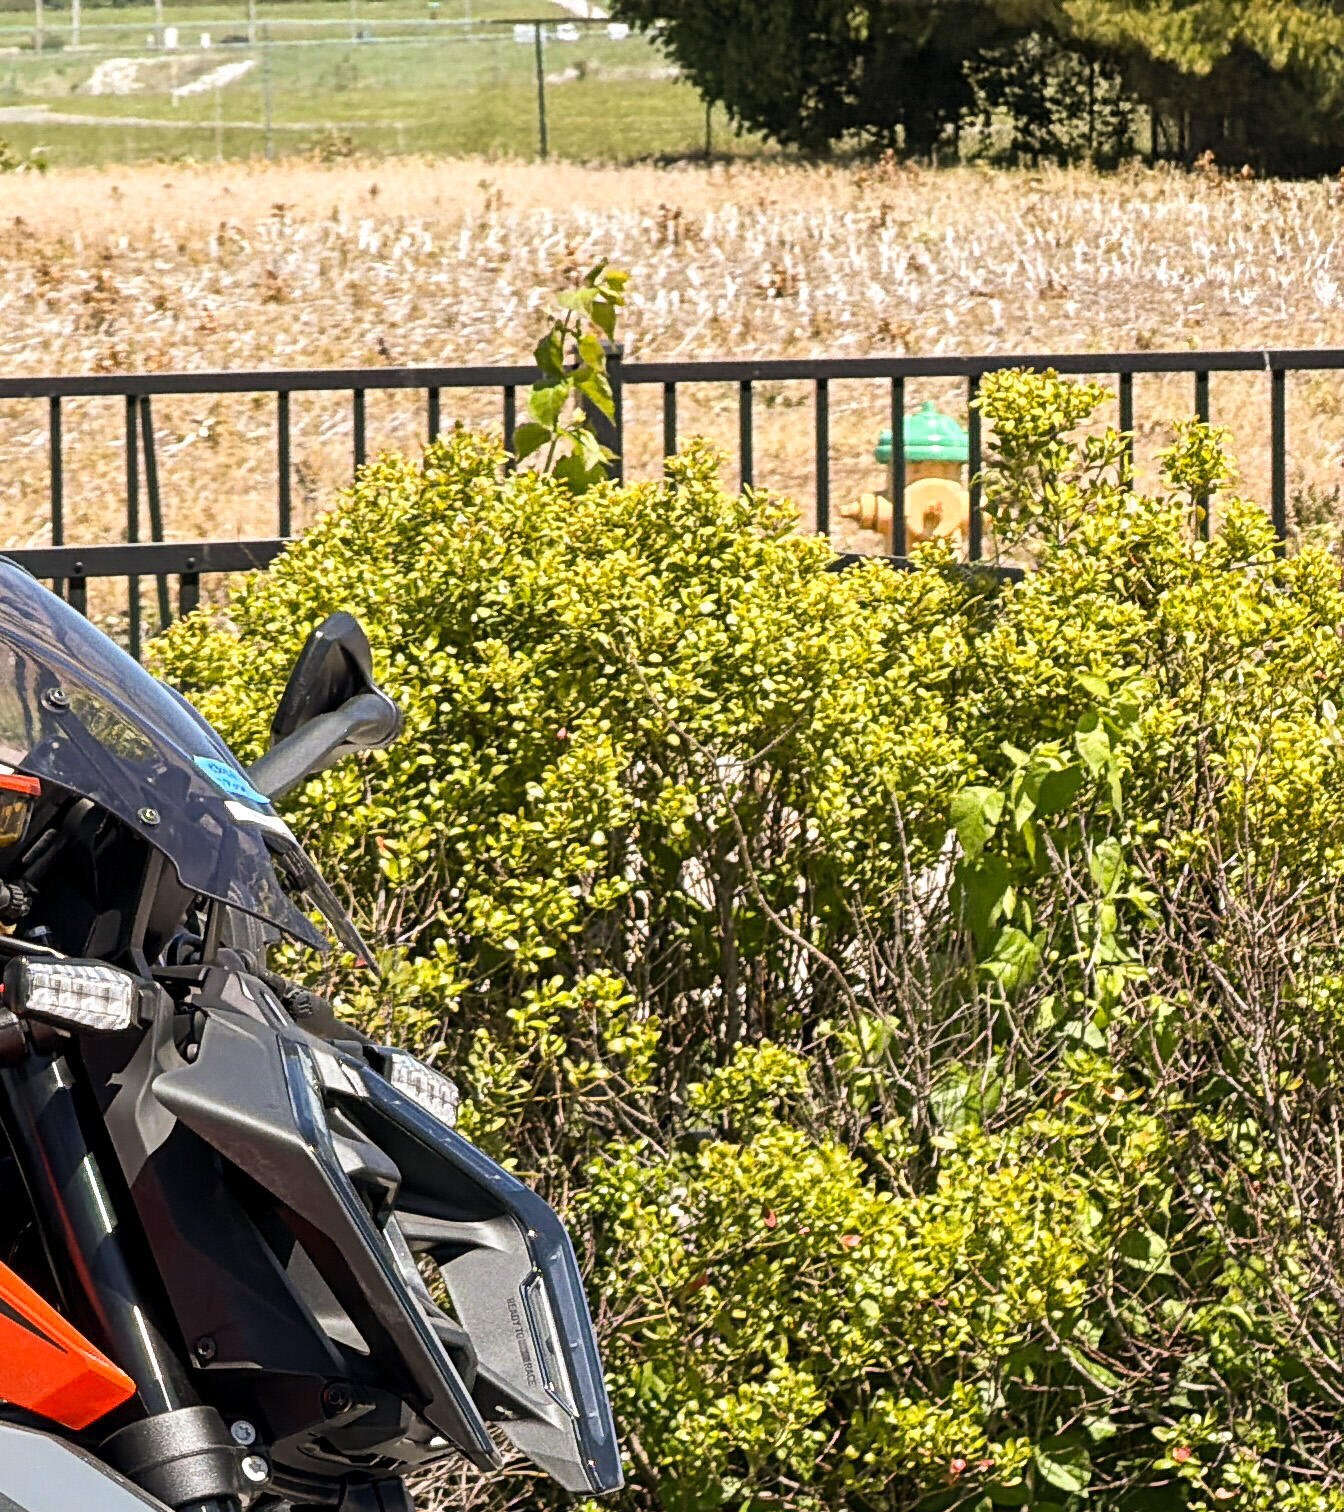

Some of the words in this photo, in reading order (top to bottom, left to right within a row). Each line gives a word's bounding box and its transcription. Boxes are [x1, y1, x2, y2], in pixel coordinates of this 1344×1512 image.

[507, 1297, 521, 1326] READY
[515, 1326, 525, 1341] TO
[523, 1360, 537, 1388] RACE
